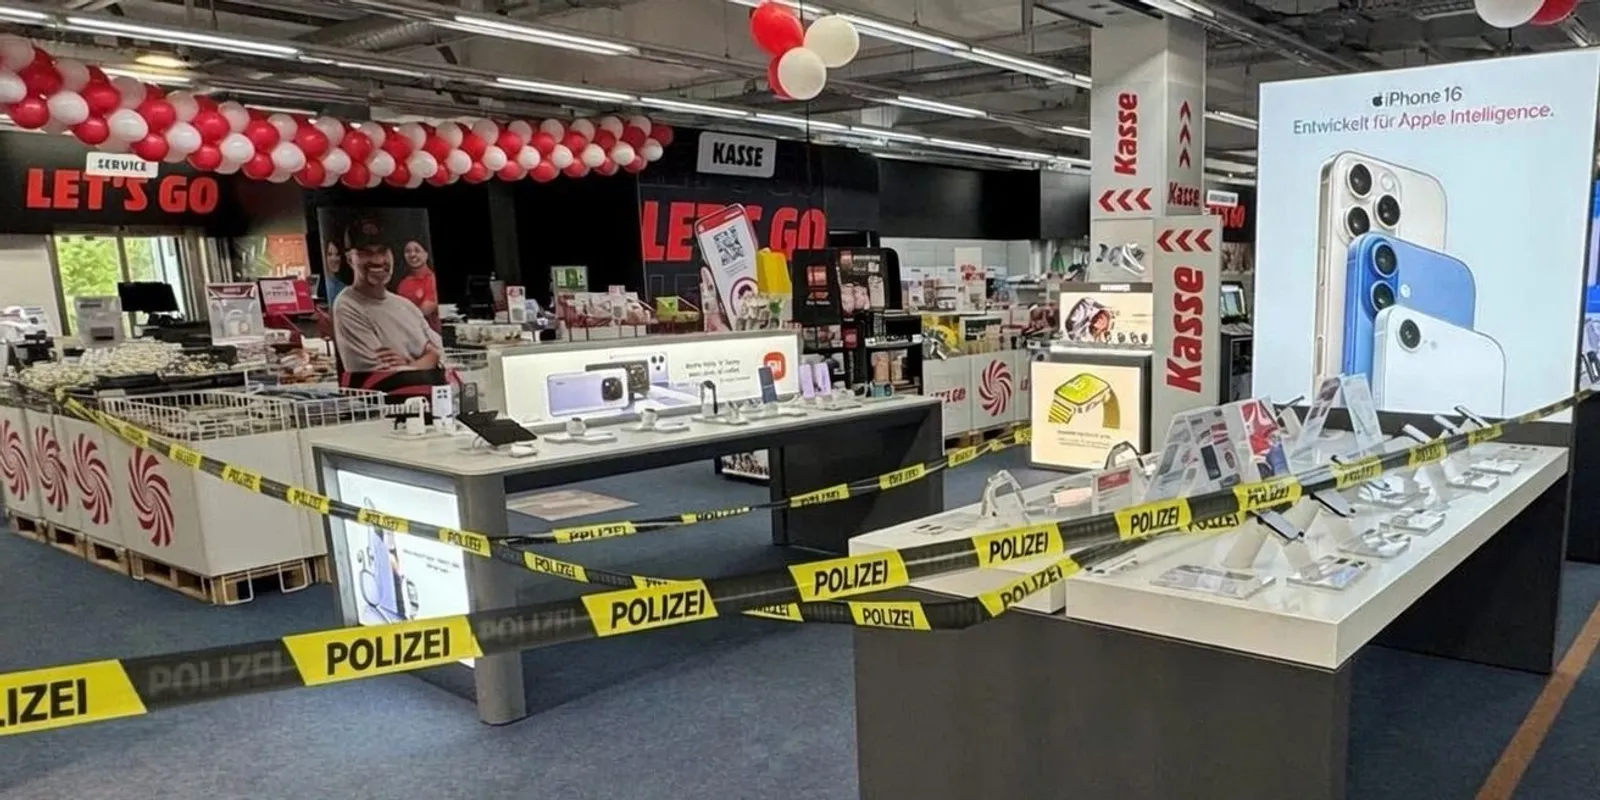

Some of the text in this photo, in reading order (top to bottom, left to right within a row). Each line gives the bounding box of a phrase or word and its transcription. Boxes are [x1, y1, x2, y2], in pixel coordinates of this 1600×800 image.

[1385, 86, 1463, 108] iPhone 16
[1114, 92, 1138, 176] Kasse
[1293, 103, 1555, 135] Entwickelt für Apple Intelligence.
[98, 158, 147, 172] SERVICE
[712, 141, 764, 168] KASSE
[26, 168, 219, 213] LET'S GO
[1166, 181, 1200, 207] Kasse
[770, 206, 827, 261] GO
[1165, 265, 1205, 393] Kasse
[1130, 505, 1180, 535] POLIZEI
[446, 530, 482, 552] POLIZEI
[989, 531, 1049, 563] POLIZEI
[534, 556, 576, 578] POLIZEI
[813, 559, 889, 596] POLIZEI
[1000, 565, 1063, 608] POLIZEI
[610, 589, 705, 629] POLIZEI
[863, 607, 914, 627] POLIZEI
[326, 627, 450, 676] POLIZEI
[151, 650, 283, 695] POLIZEI
